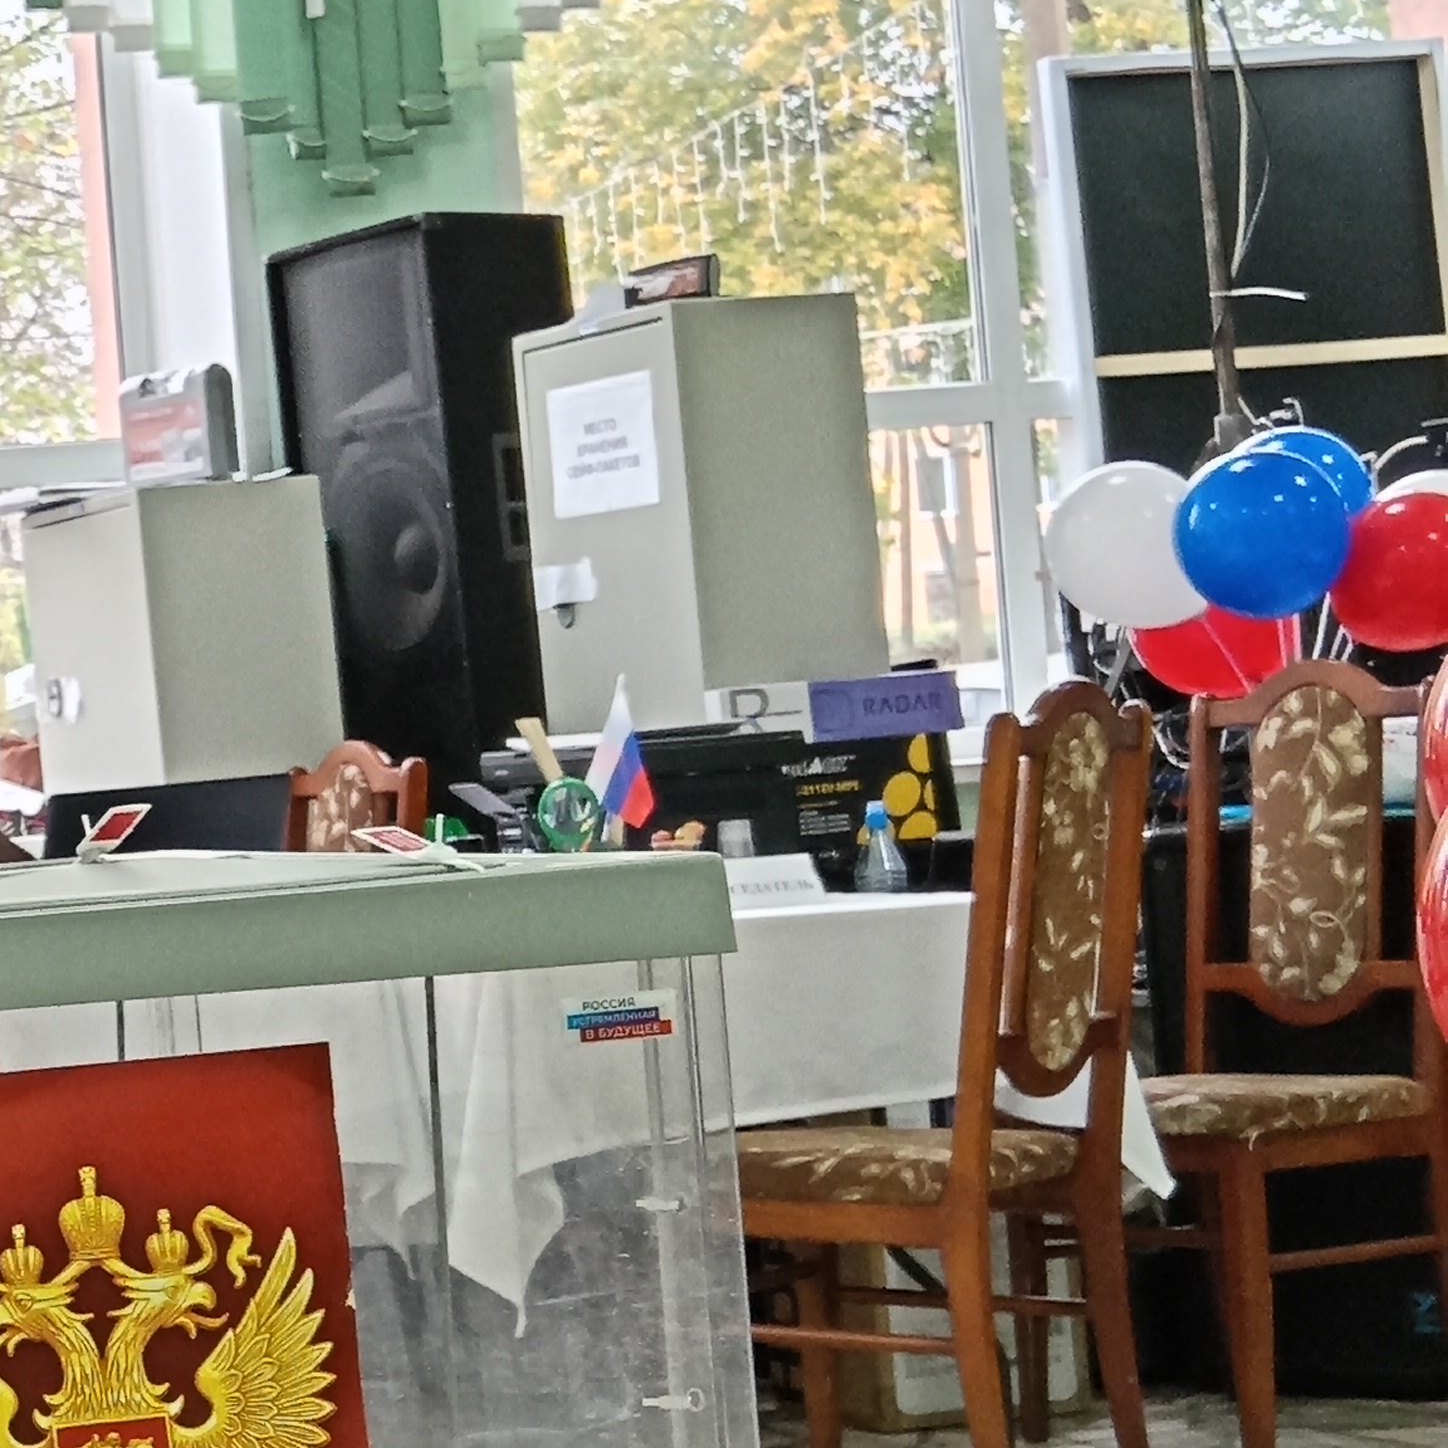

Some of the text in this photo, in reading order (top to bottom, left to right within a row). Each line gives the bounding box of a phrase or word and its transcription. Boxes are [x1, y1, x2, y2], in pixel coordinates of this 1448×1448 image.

[862, 690, 942, 717] RADAR
[582, 996, 636, 1011] РОССИЯ
[585, 1023, 661, 1040] В БУДУЩЕЕ
